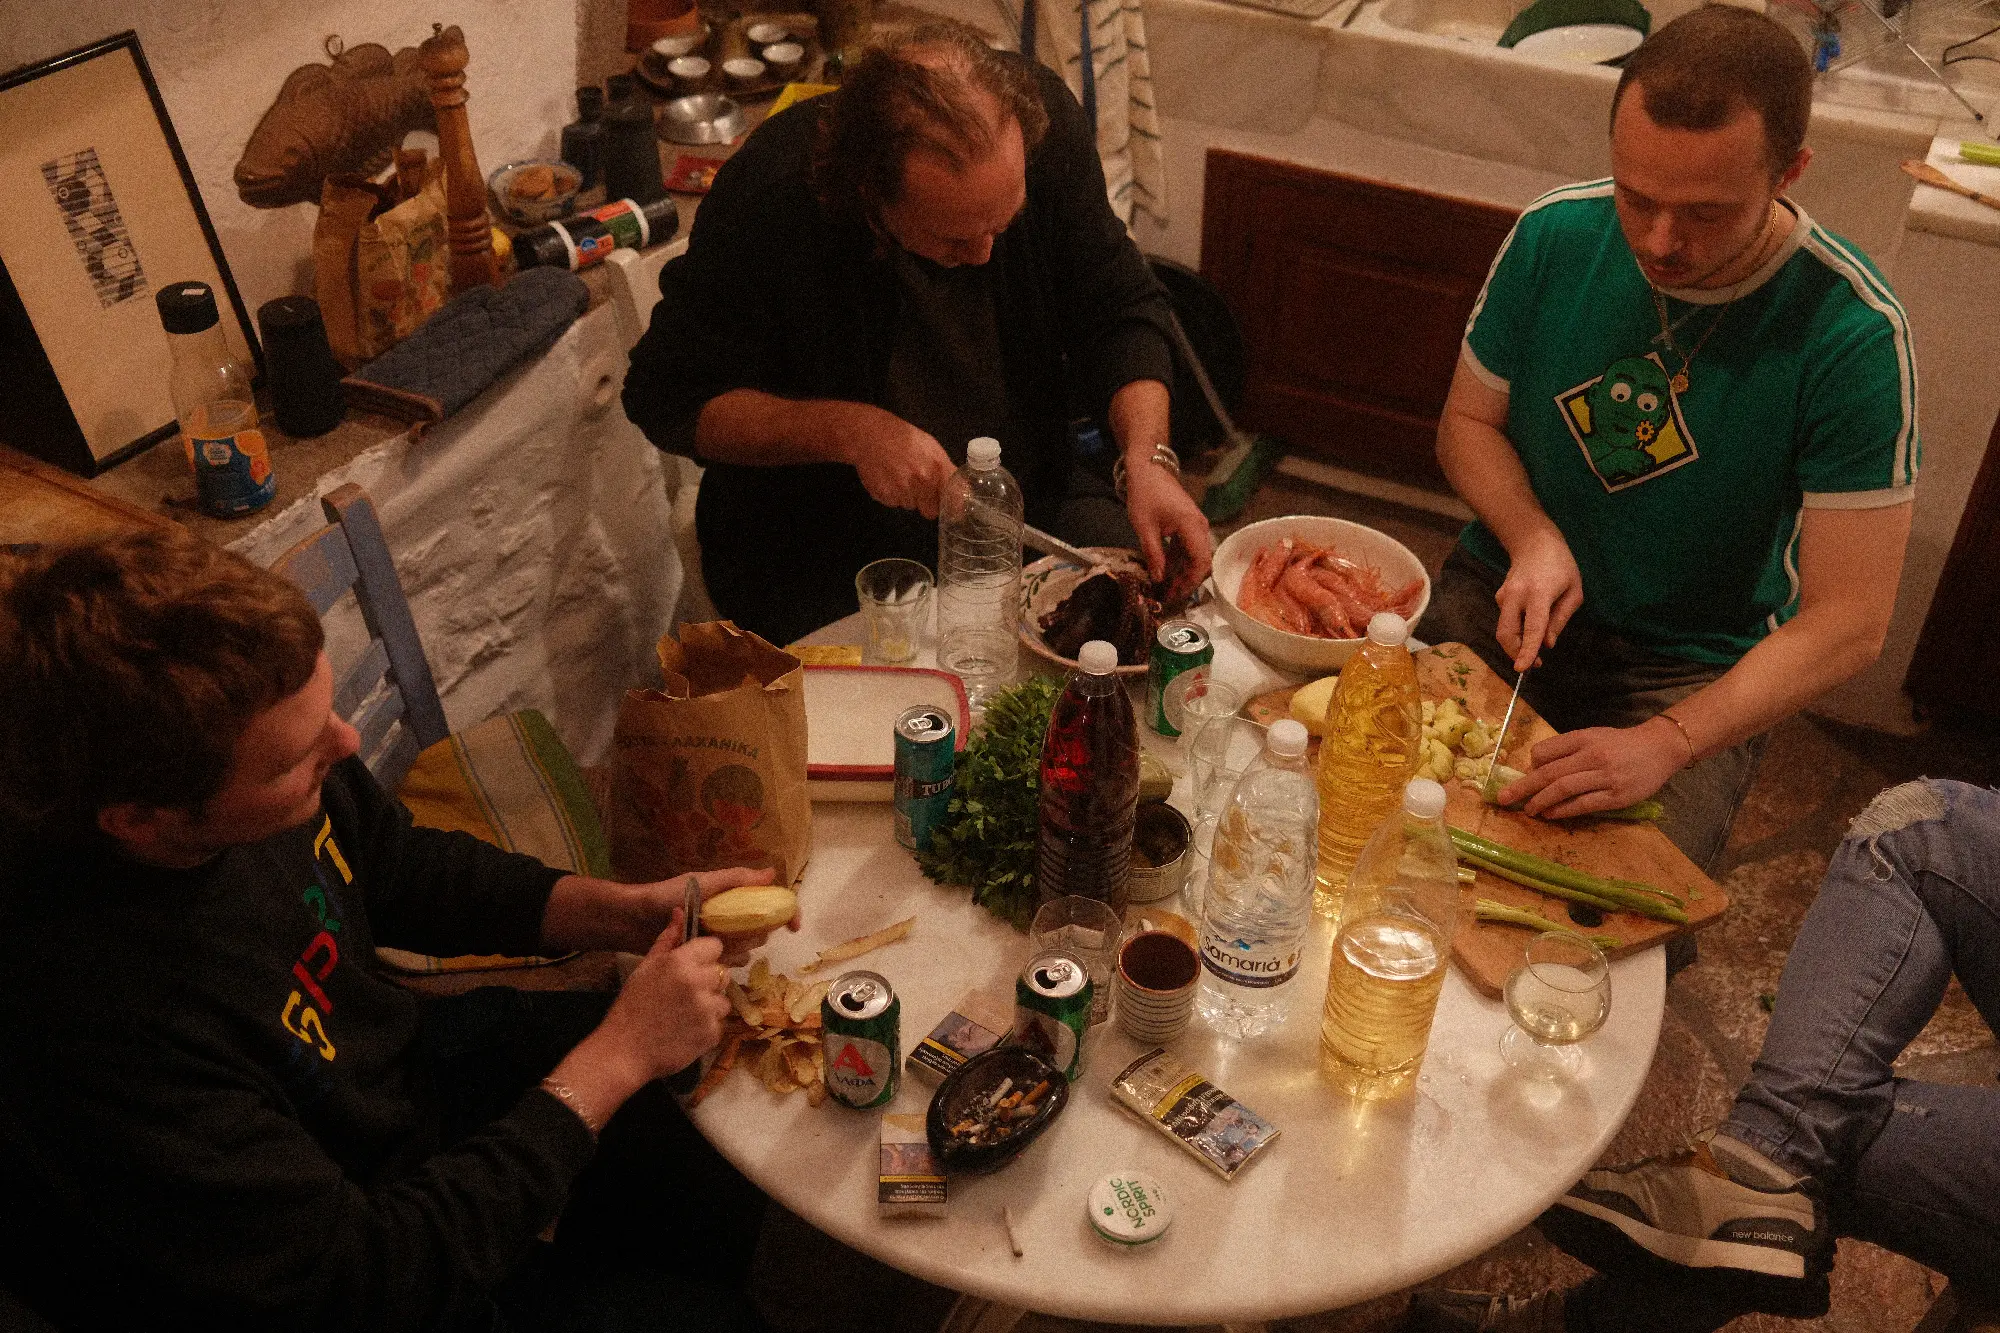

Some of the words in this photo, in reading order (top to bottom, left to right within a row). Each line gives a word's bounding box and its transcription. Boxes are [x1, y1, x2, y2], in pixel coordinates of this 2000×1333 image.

[1109, 1177, 1146, 1229] NORDIC
[1126, 1180, 1156, 1217] SPIRIT
[1732, 1230, 1752, 1239] new
[1753, 1230, 1794, 1243] balance
